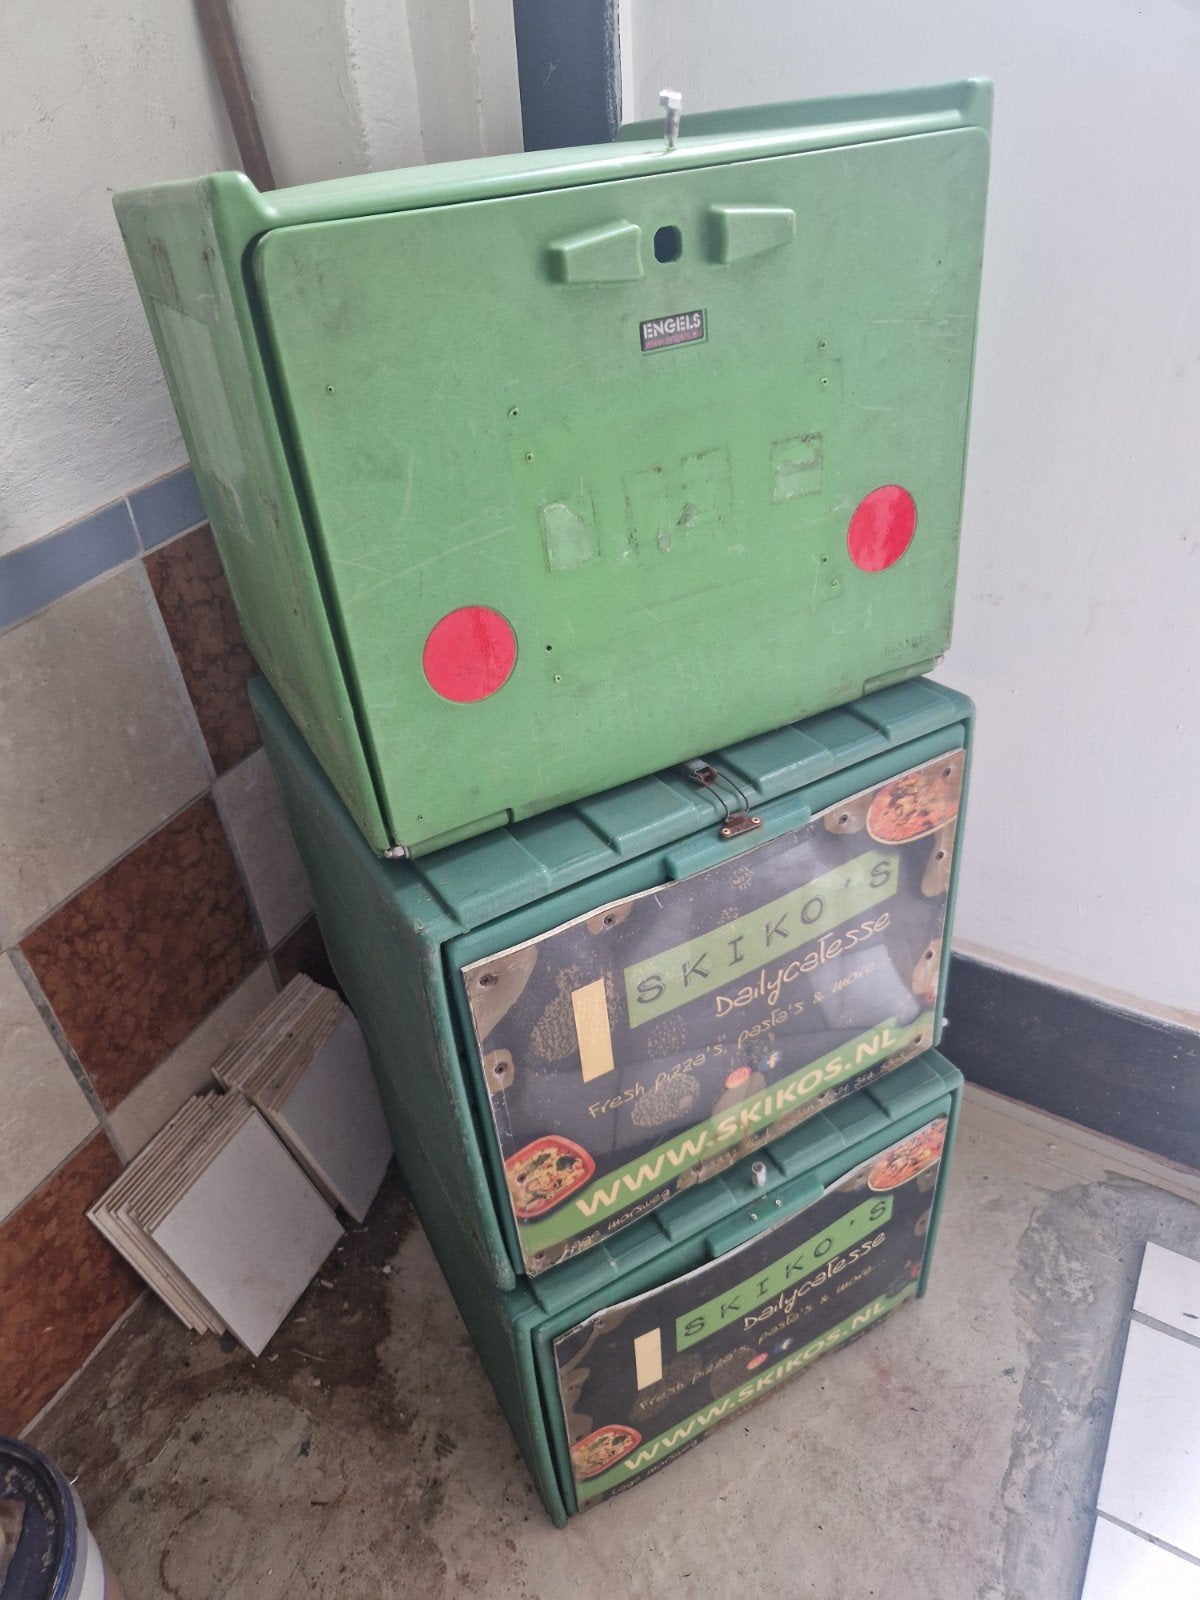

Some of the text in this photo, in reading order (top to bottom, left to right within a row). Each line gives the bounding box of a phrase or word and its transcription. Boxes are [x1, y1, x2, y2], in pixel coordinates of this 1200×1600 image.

[643, 313, 701, 338] ENGELS
[636, 859, 892, 1004] SKIKO'S
[576, 1028, 896, 1217] WWW.SKIKOS.NL
[588, 1081, 645, 1118] Fresh
[737, 1001, 804, 1050] pasta's
[812, 991, 825, 1004] &
[683, 1201, 886, 1337] SKIKO'S
[624, 1302, 887, 1470] WWW.SKIKOS.NL
[639, 1381, 685, 1410] Fresh
[758, 1304, 813, 1345] pasta's
